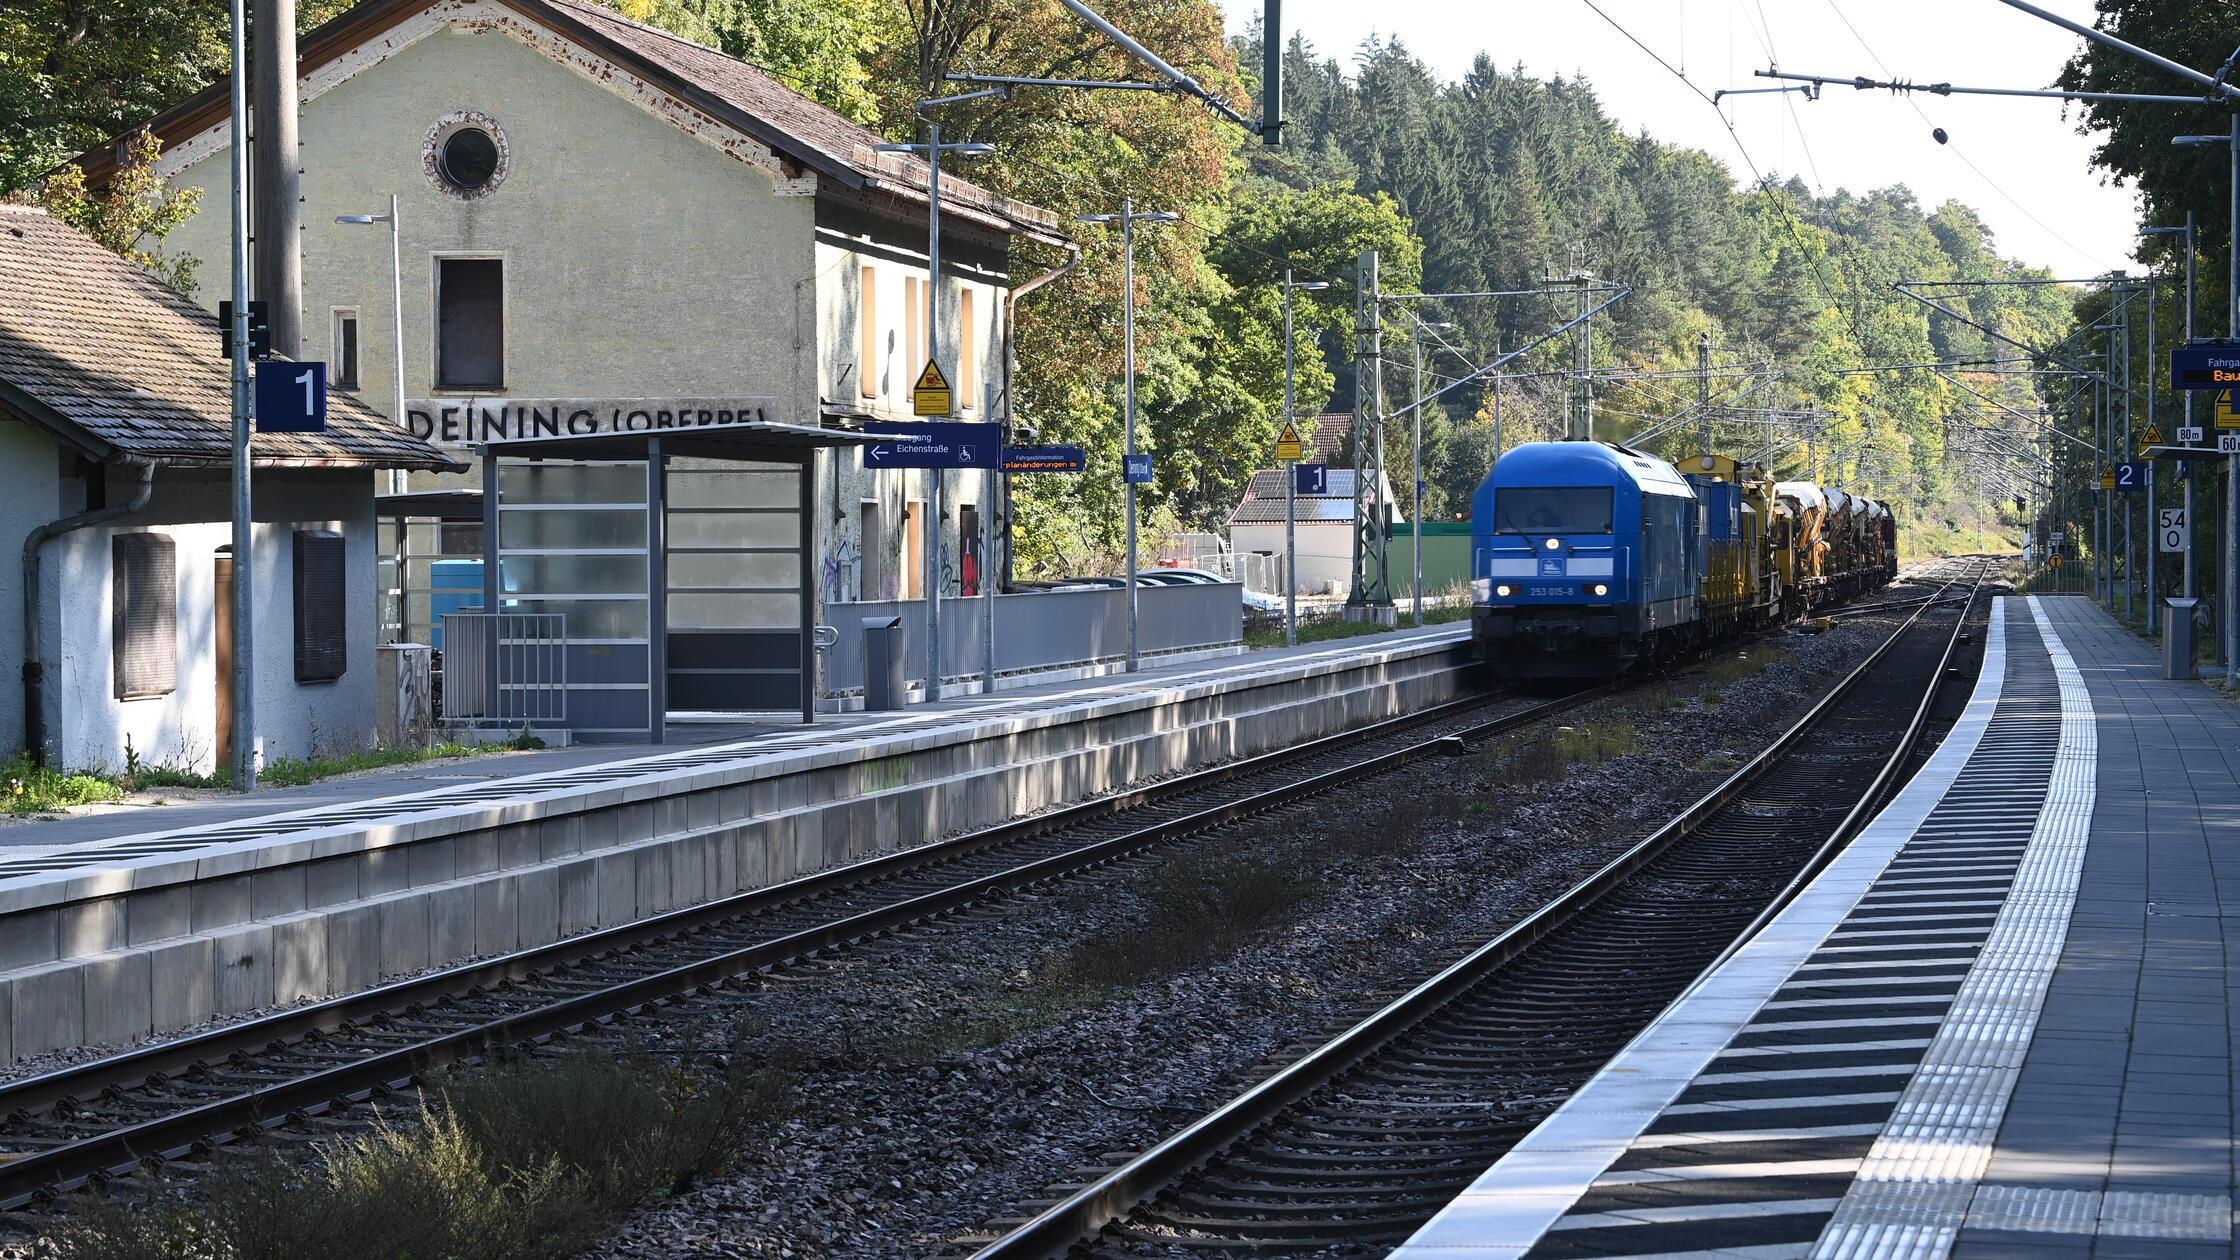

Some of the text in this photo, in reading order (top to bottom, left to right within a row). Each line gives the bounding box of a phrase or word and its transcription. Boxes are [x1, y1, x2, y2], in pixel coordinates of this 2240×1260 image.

[295, 369, 314, 416] 1
[407, 407, 598, 442] DEINING
[896, 444, 949, 453] Eichenstraße
[1313, 467, 1323, 487] 1
[2119, 465, 2133, 485] 2
[2160, 511, 2185, 529] 54
[2166, 530, 2180, 548] 0
[1530, 587, 1547, 596] 253
